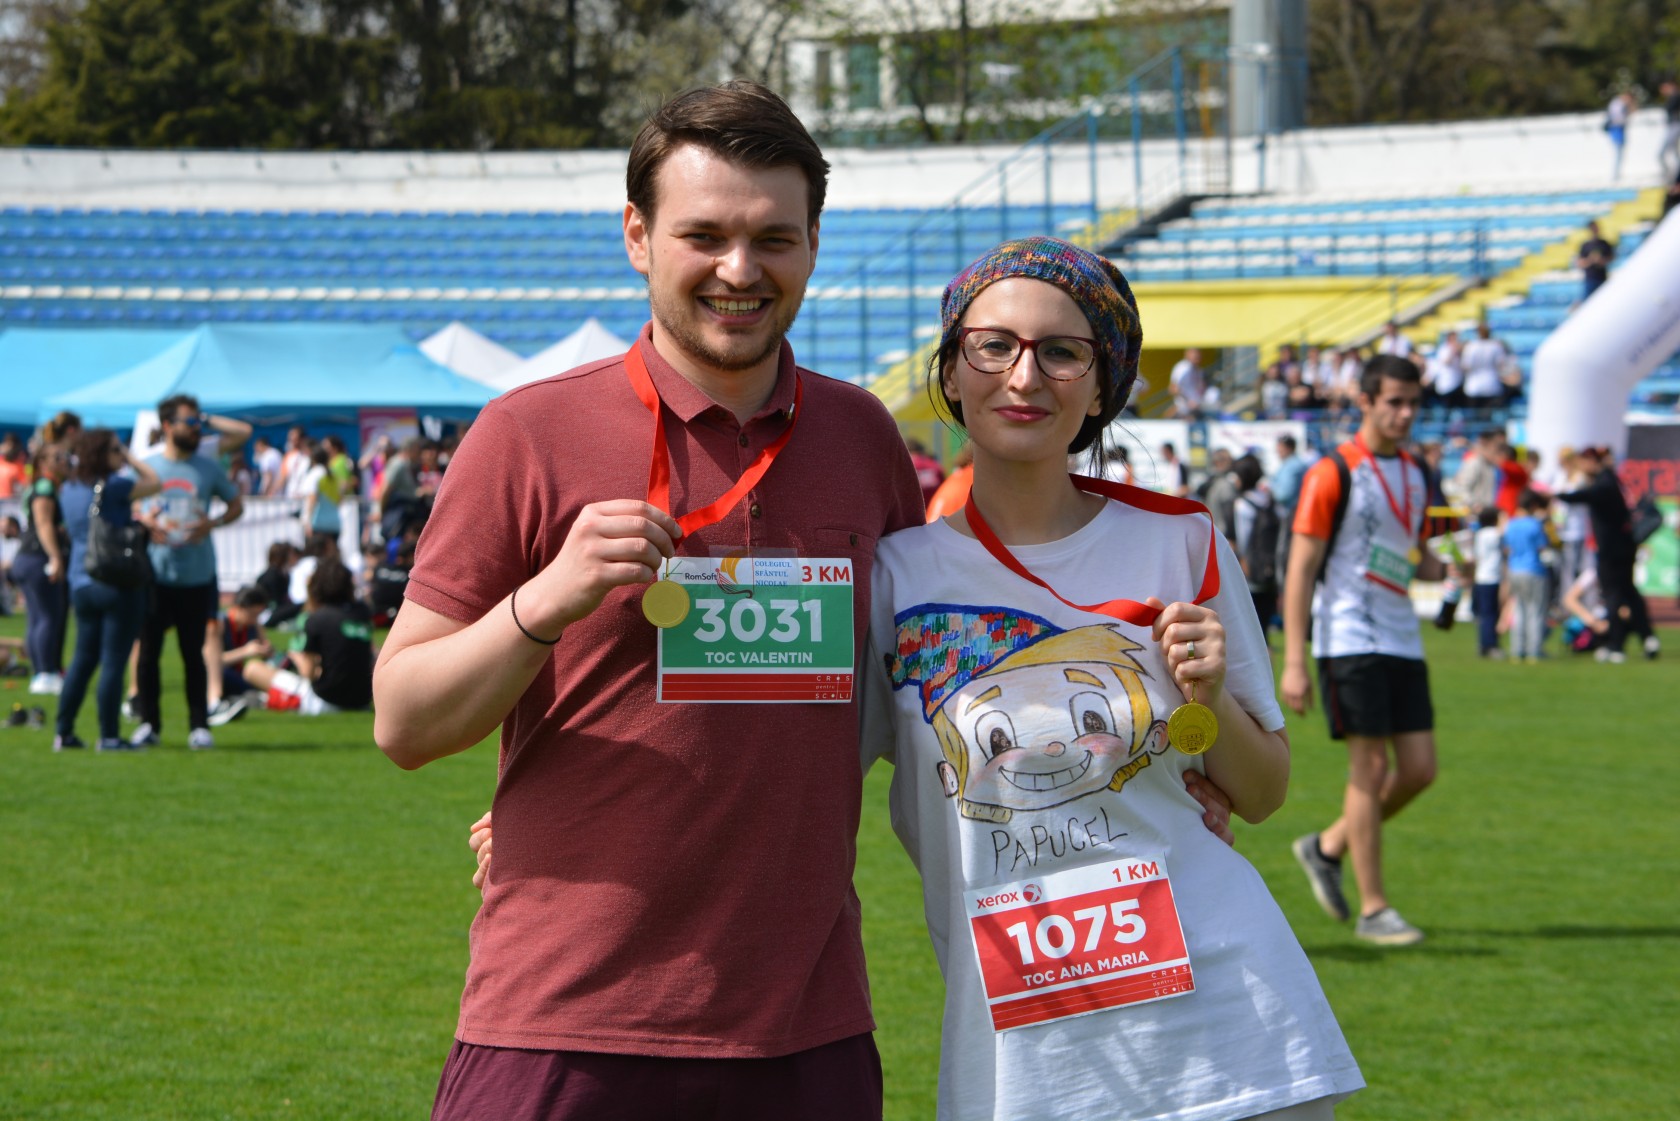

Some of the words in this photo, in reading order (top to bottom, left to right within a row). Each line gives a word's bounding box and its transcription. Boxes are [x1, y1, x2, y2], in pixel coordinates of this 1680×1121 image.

[754, 560, 793, 568] COLEGIUL
[684, 572, 718, 582] RomSoft
[801, 565, 814, 583] 3
[819, 565, 850, 583] KM
[693, 598, 823, 643] 3031
[705, 652, 735, 664] TOC
[739, 652, 813, 664] VALENTIN
[991, 807, 1128, 875] PAPUCEL
[1112, 867, 1122, 883] 1
[1127, 861, 1159, 880] KM
[976, 891, 1019, 909] xerox
[1006, 898, 1147, 966] 1075
[1022, 970, 1056, 987] TOC
[1060, 963, 1094, 980] ANA
[1097, 950, 1150, 971] MARIA
[1152, 978, 1174, 987] pentru
